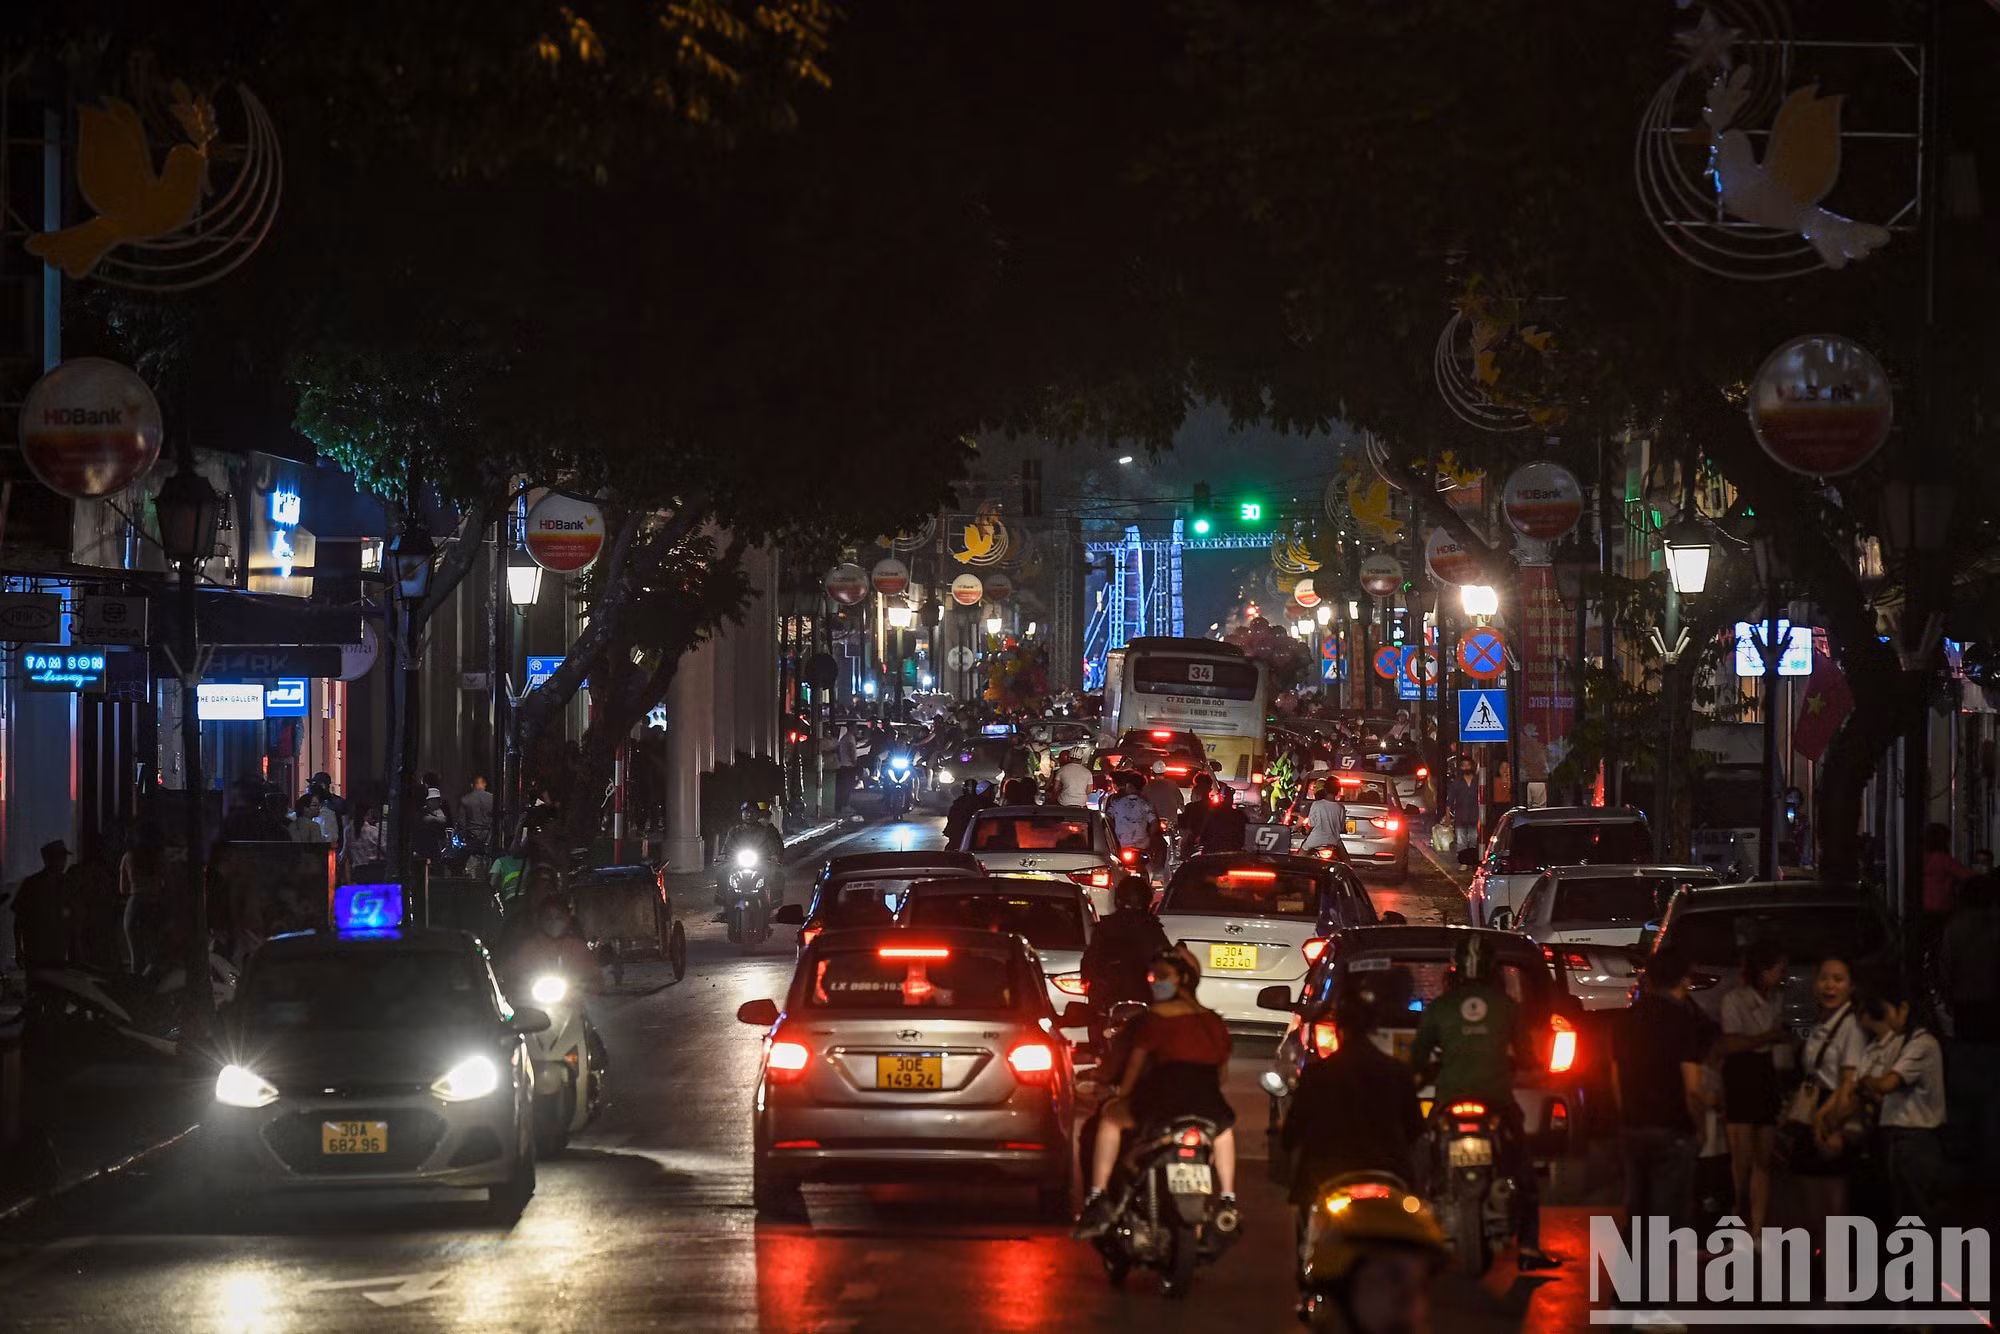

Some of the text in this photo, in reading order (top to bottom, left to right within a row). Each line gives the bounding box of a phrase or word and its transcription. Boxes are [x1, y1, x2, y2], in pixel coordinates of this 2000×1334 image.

[43, 408, 122, 425] HDBank
[1517, 488, 1562, 499] HDBank
[1242, 504, 1260, 519] 30
[539, 520, 584, 530] HDBank
[26, 656, 103, 669] TAM SON
[1191, 667, 1210, 679] 34
[1256, 828, 1279, 851] G7
[1224, 947, 1242, 956] 30A
[897, 1059, 924, 1072] 30E
[341, 1123, 367, 1136] 30A
